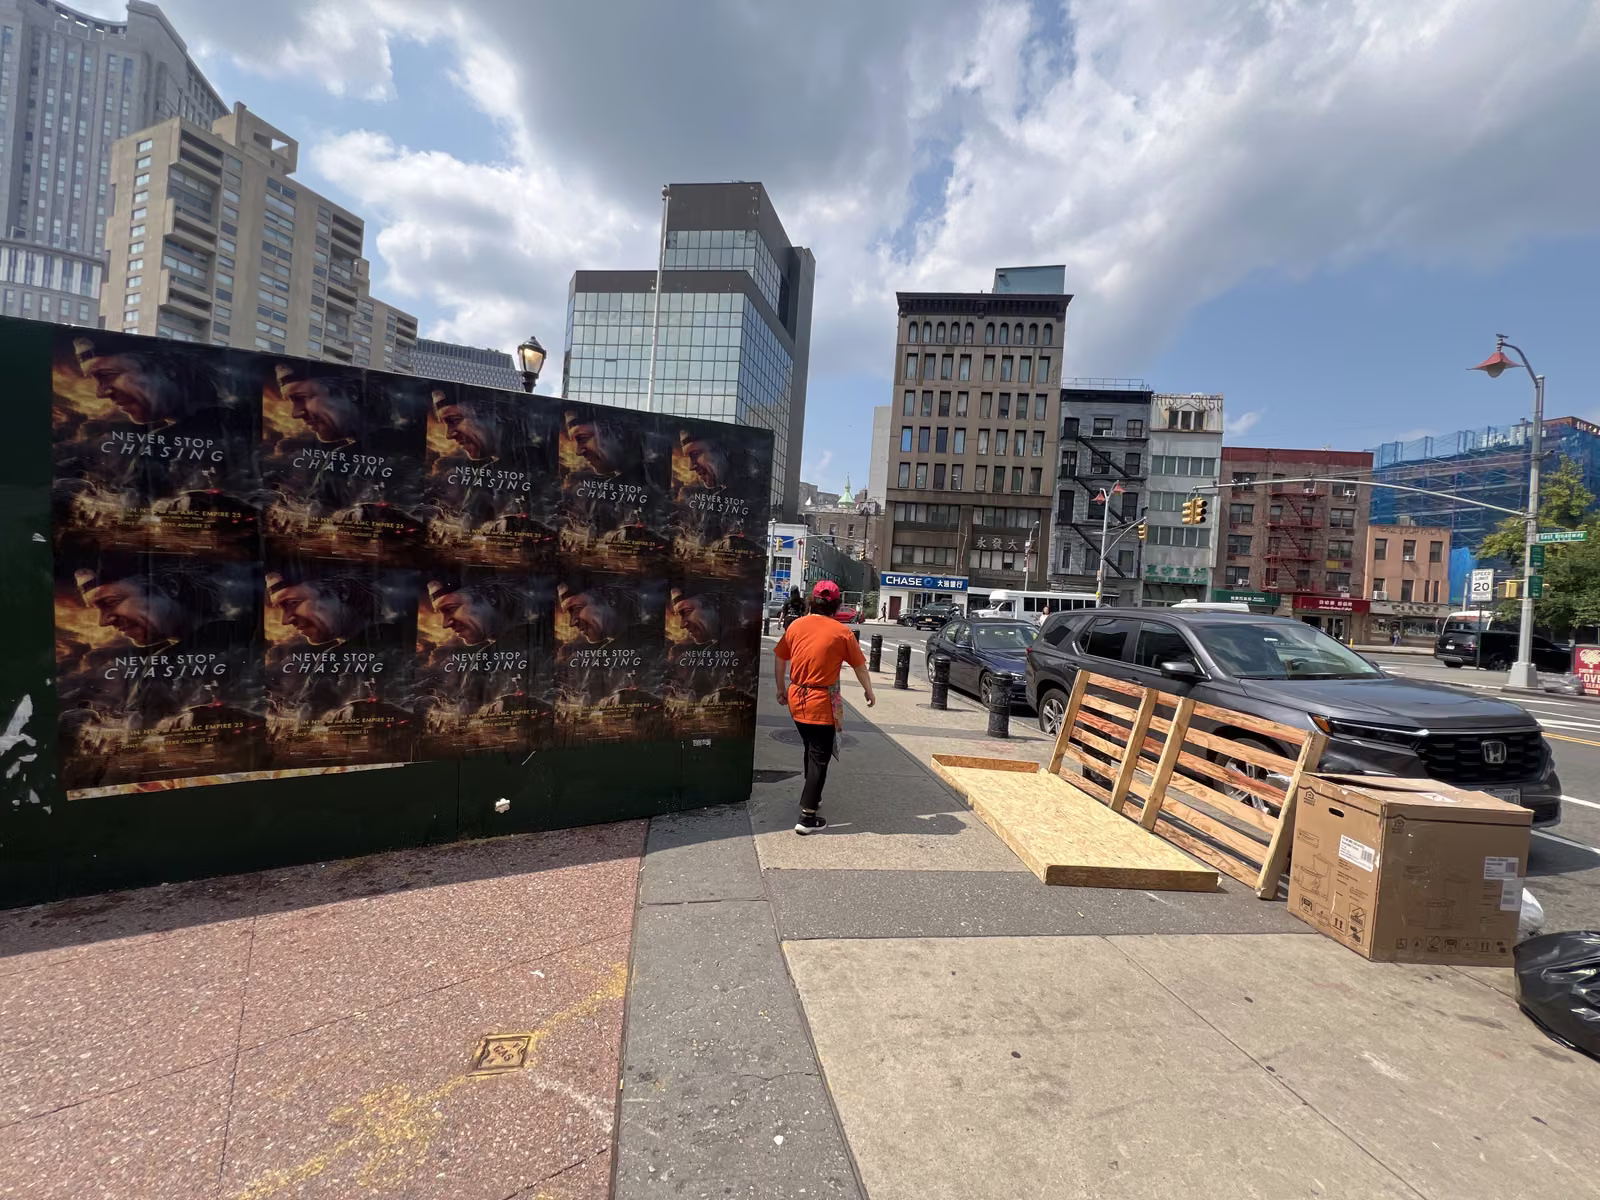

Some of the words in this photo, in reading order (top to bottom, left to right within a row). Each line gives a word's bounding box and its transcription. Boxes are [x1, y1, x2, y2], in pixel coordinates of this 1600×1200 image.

[112, 431, 165, 445] NEVER
[174, 437, 214, 448] STOP
[101, 441, 224, 462] CHASING
[303, 448, 346, 461] NEVER
[353, 454, 384, 465] STOP
[293, 457, 393, 477] CHASING
[455, 466, 492, 477] NEVER
[497, 470, 524, 480] STOP
[448, 475, 531, 491] CHASING
[583, 480, 614, 491] NEVER
[619, 484, 641, 493] STOP
[576, 488, 648, 503] CHASING
[694, 493, 721, 503] NEVER
[724, 497, 744, 506] STOP
[689, 500, 748, 515] CHASING
[1555, 532, 1584, 540] Broadway
[975, 537, 1034, 551] 永發大
[886, 576, 922, 586] CHASE
[1474, 582, 1490, 591] 20
[115, 655, 168, 666] NEVER
[177, 654, 216, 664] STOP
[293, 653, 336, 662] NEVER
[343, 653, 375, 662] STOP
[452, 653, 488, 662] NEVER
[494, 652, 521, 660] STOP
[577, 650, 607, 658] NEVER
[612, 649, 635, 657] STOP
[685, 650, 711, 658] NEVER
[282, 663, 384, 673] CHASING
[444, 660, 527, 672] CHASING
[570, 657, 642, 667] CHASING
[679, 658, 739, 667] CHASING
[104, 664, 226, 679] CHASING
[493, 1045, 514, 1062] GAS
